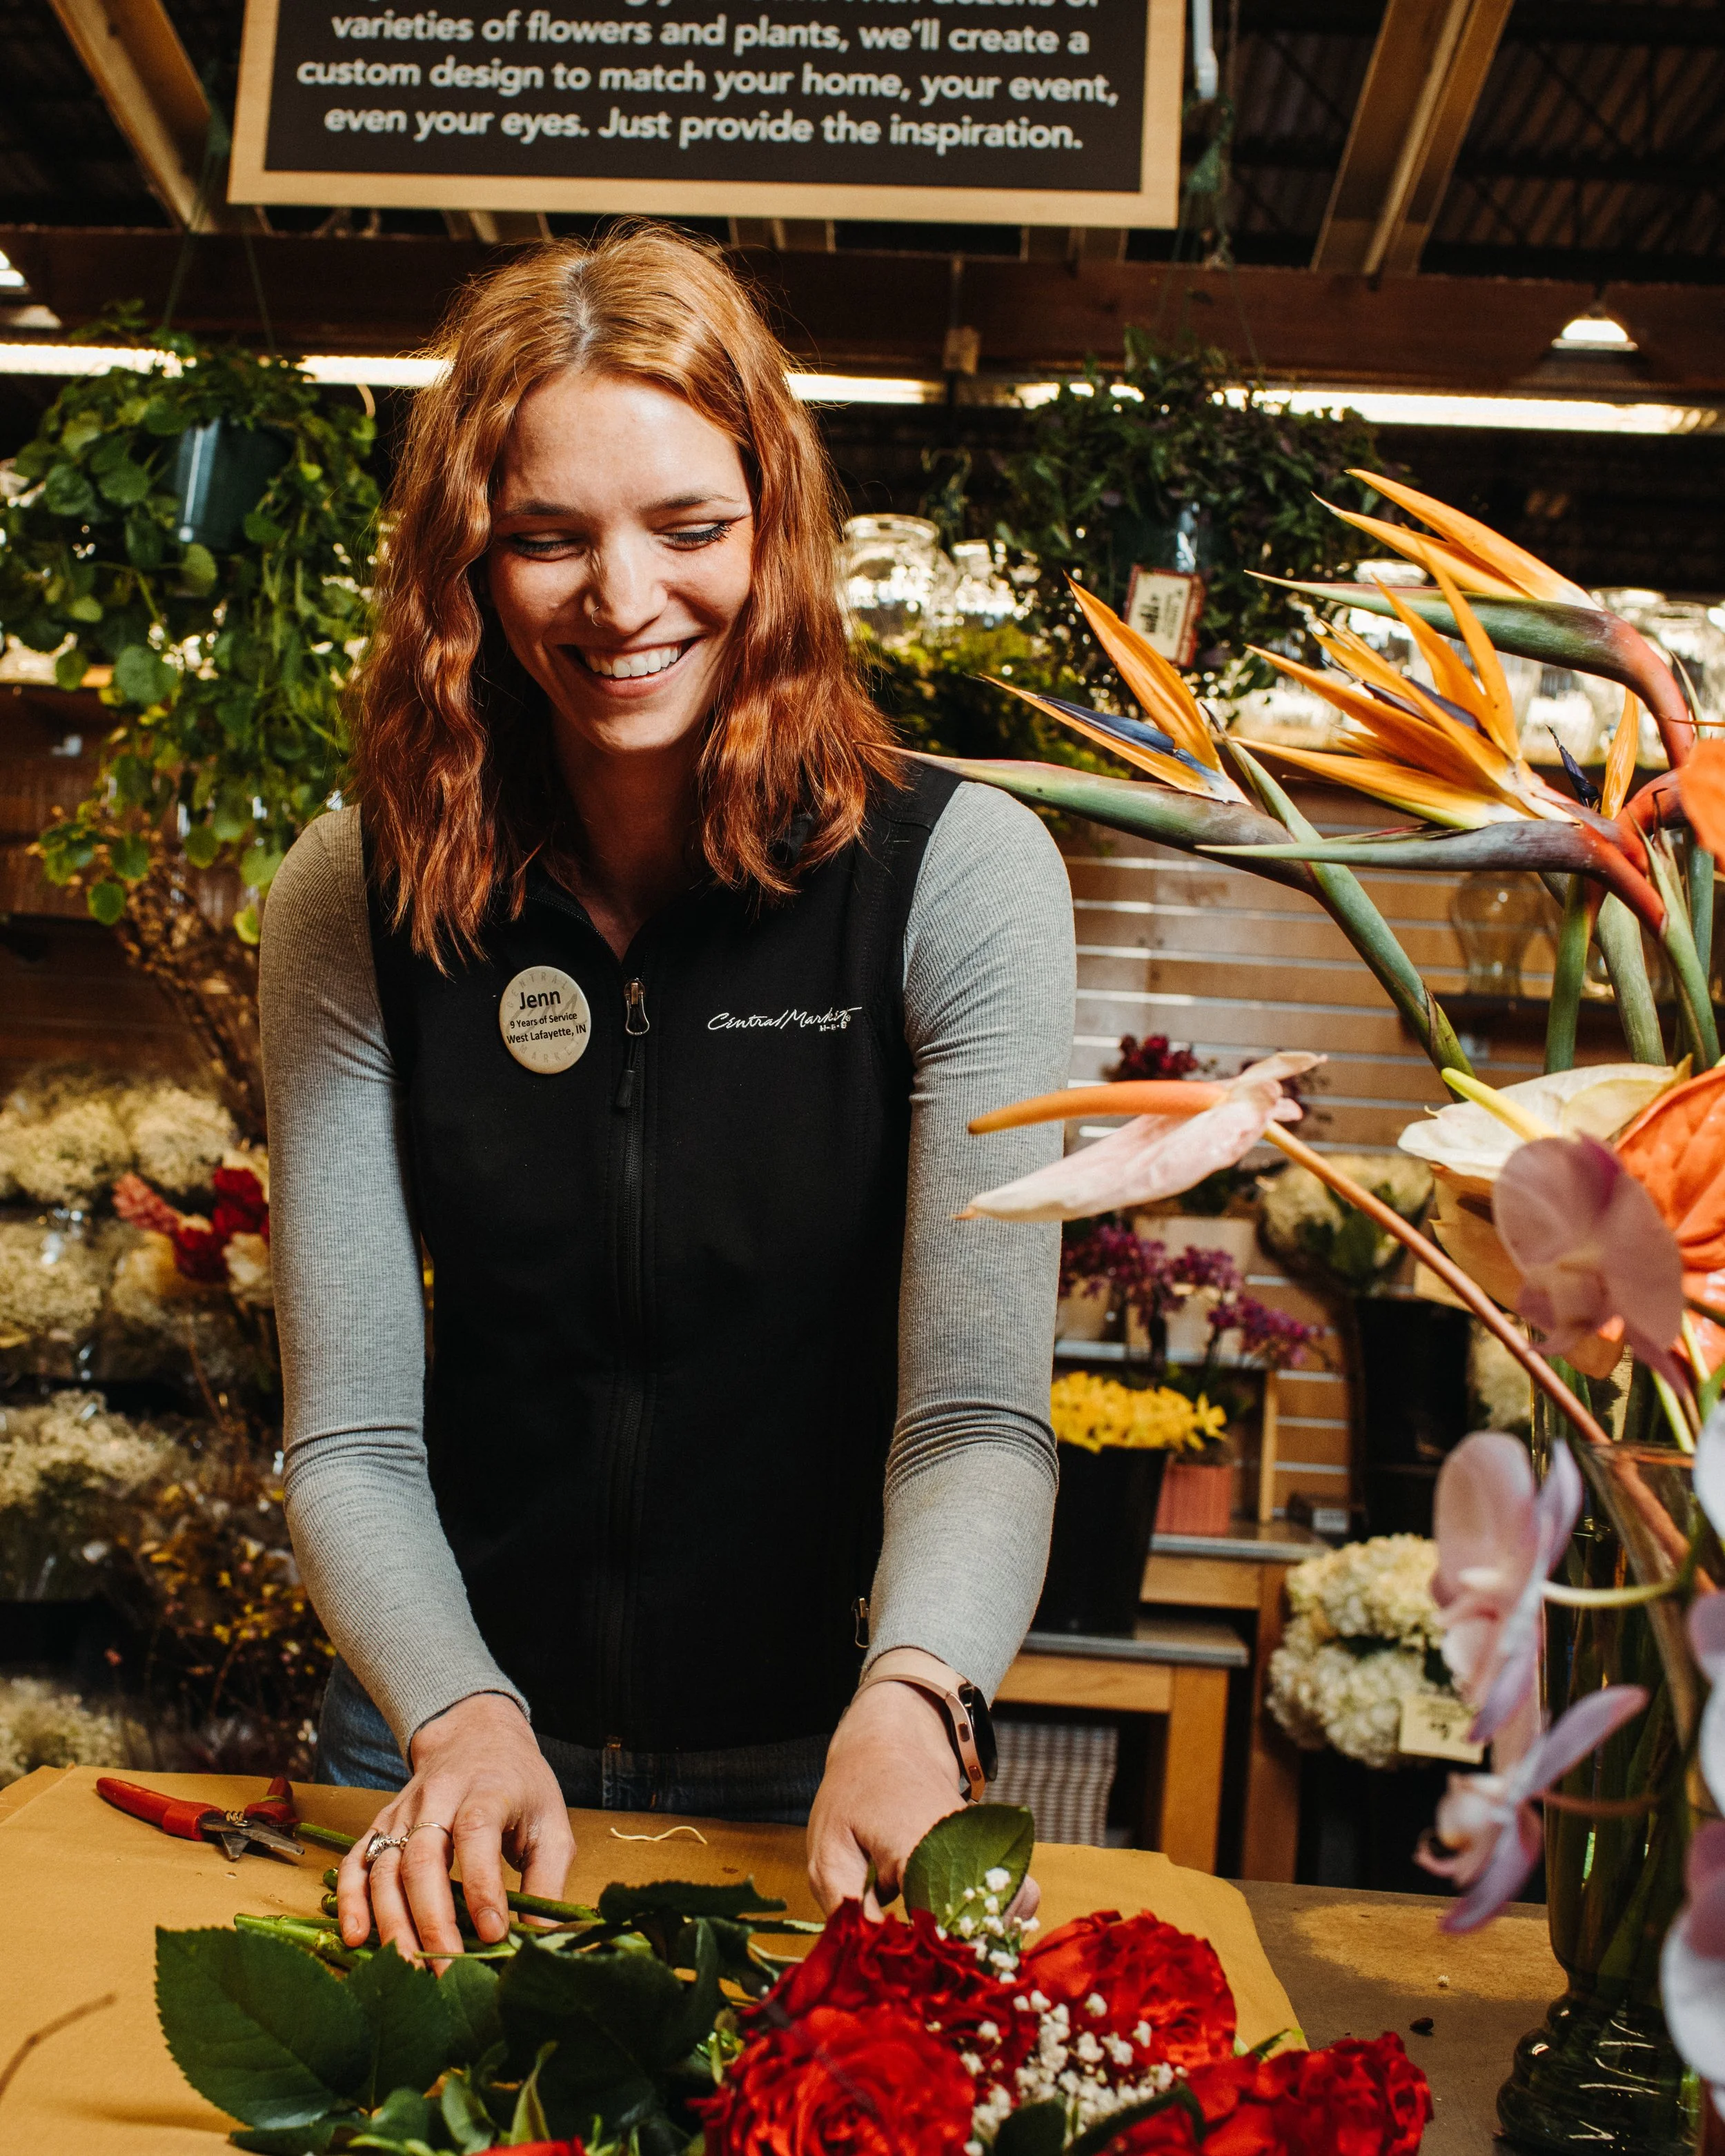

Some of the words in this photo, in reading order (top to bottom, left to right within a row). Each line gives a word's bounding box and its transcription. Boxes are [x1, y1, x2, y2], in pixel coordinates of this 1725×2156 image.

[331, 9, 474, 41] varieties
[481, 9, 522, 42] of
[525, 10, 653, 45] flowers
[660, 14, 727, 46] and
[733, 14, 849, 56] plants,
[948, 26, 1060, 54] create
[1067, 31, 1090, 55] a
[297, 58, 422, 86] custom
[429, 55, 544, 97] design
[551, 62, 591, 90] to
[599, 59, 707, 92] match
[712, 70, 795, 101] your
[801, 62, 911, 101] home,
[918, 75, 1002, 107] your
[1008, 75, 1118, 107] event,
[324, 108, 407, 132] even
[413, 111, 495, 142] your
[500, 112, 590, 144] eyes.
[598, 106, 672, 139] Just
[678, 108, 814, 150] provide
[820, 110, 882, 144] the
[889, 113, 1083, 156] inspiration.
[520, 990, 561, 1010] Jenn
[511, 1020, 515, 1029] 9
[517, 1018, 538, 1028] Years
[540, 1016, 548, 1025] of
[549, 1012, 578, 1023] Service
[708, 1009, 789, 1030] Central
[506, 1035, 529, 1044] West
[531, 1027, 574, 1040] Lafayette,
[576, 1024, 586, 1034] IN
